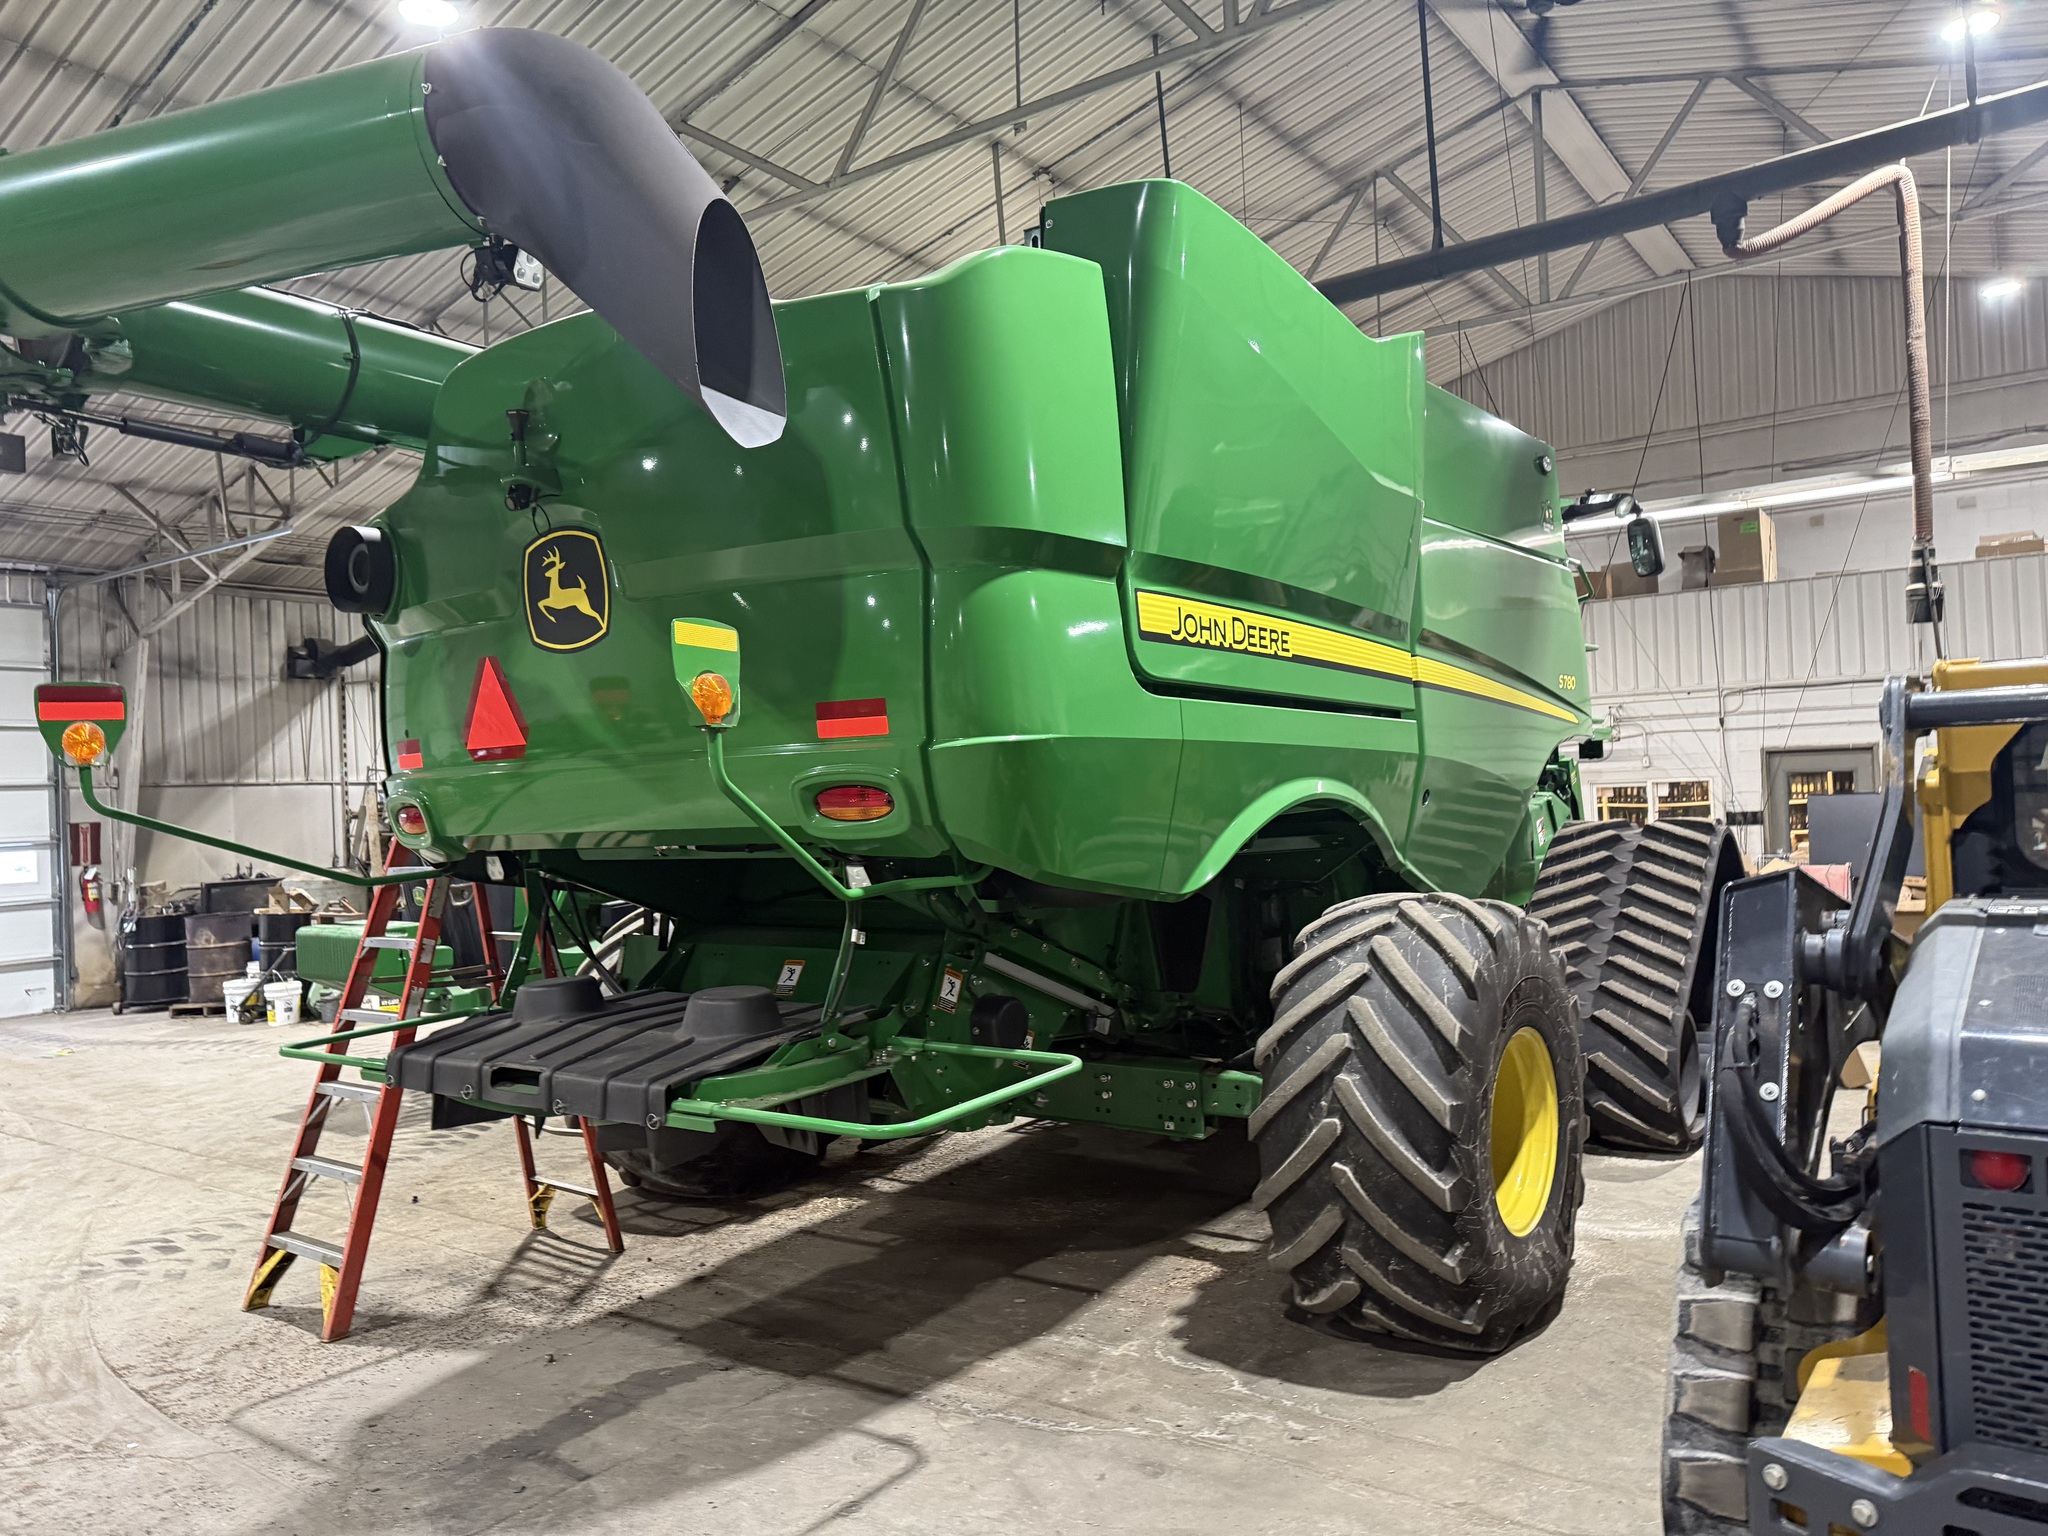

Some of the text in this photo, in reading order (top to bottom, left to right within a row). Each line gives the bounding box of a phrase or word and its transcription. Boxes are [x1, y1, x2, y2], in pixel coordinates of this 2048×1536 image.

[1171, 606, 1291, 653] JOHN DEERE
[1558, 674, 1576, 690] S780
